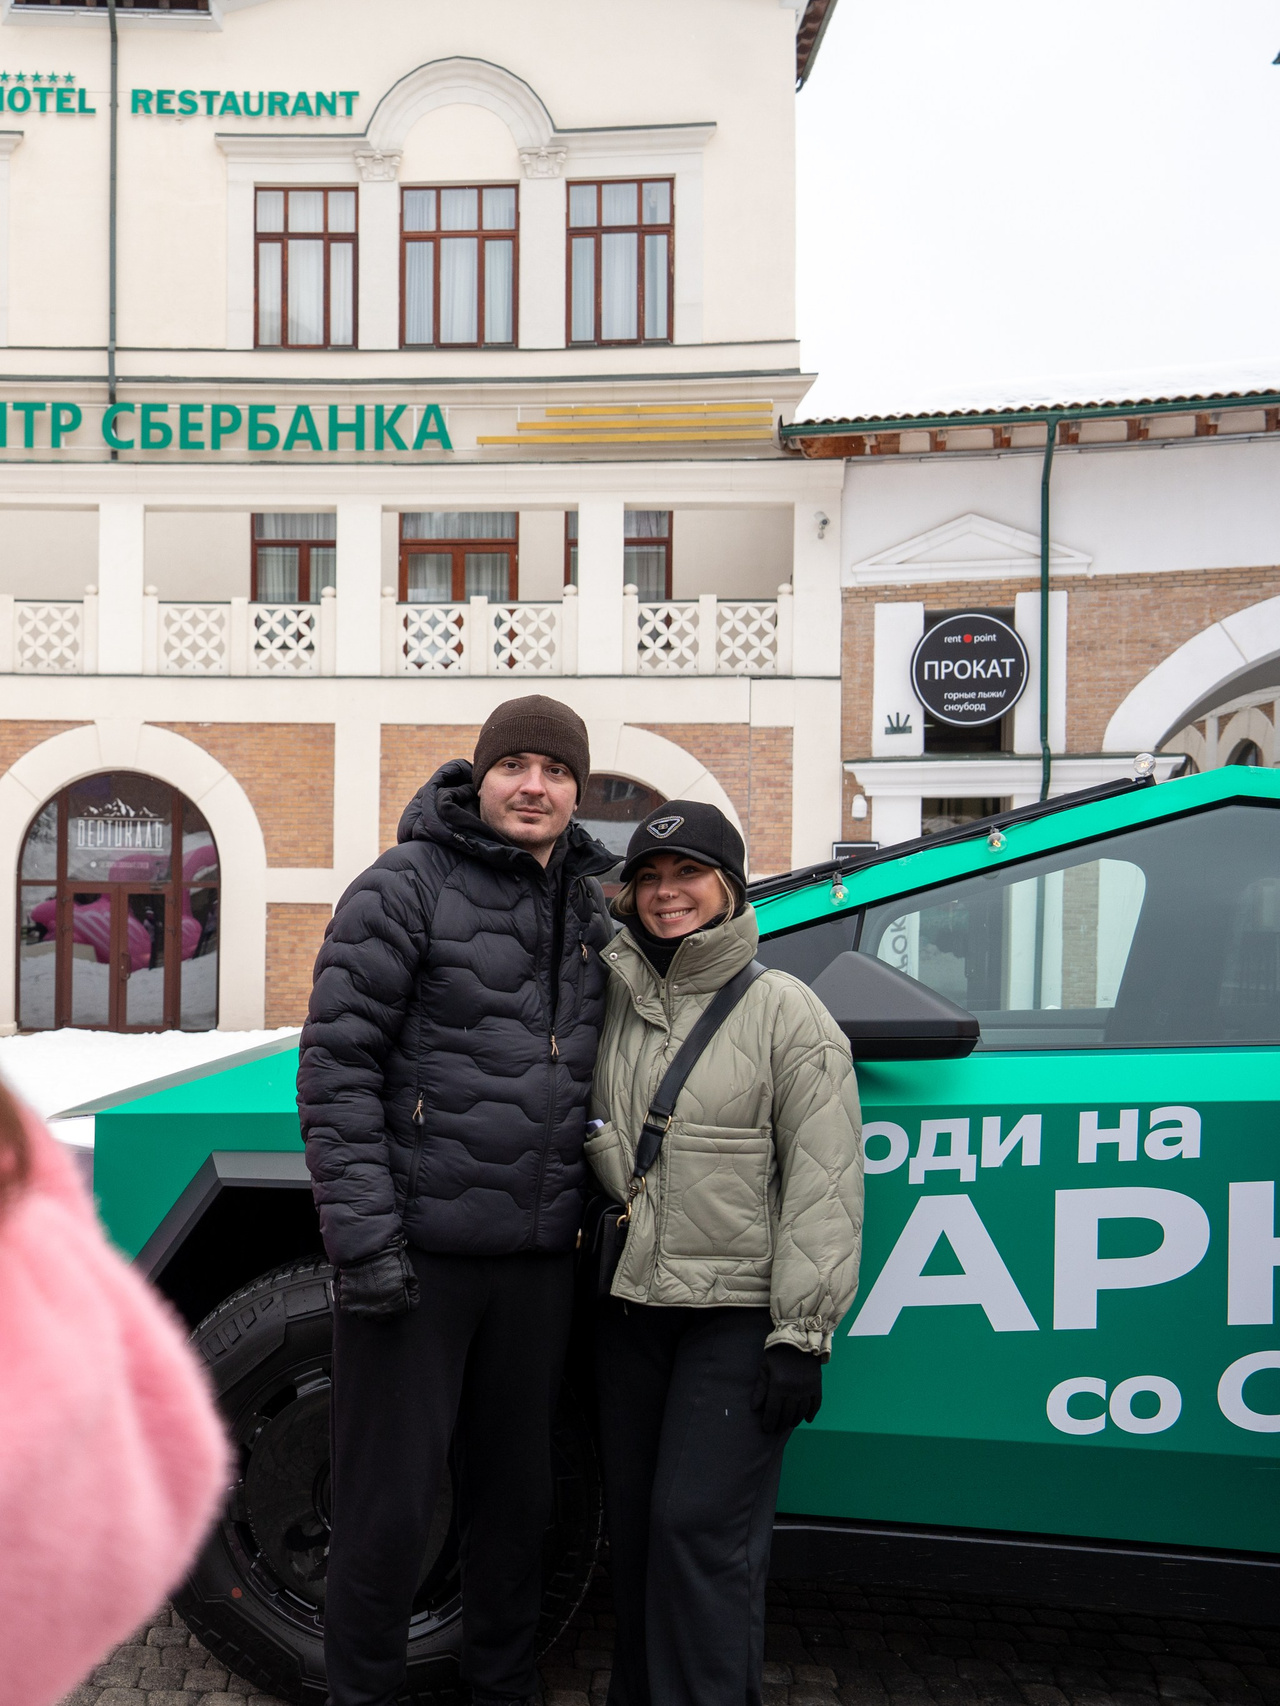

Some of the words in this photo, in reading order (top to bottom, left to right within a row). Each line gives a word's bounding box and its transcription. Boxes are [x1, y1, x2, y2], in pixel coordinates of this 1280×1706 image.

[131, 89, 359, 117] RESTAURANT
[102, 402, 454, 451] СБЕРБАНКА
[944, 635, 962, 643] rent
[973, 633, 997, 644] point
[924, 658, 1015, 681] ПРОКАТ
[943, 701, 987, 713] сноуборд
[944, 692, 977, 701] горные
[78, 820, 163, 848] ВЕРТИКАЛЬ
[863, 1114, 1042, 1185] оди
[1078, 1105, 1202, 1164] на
[1046, 1374, 1183, 1436] со
